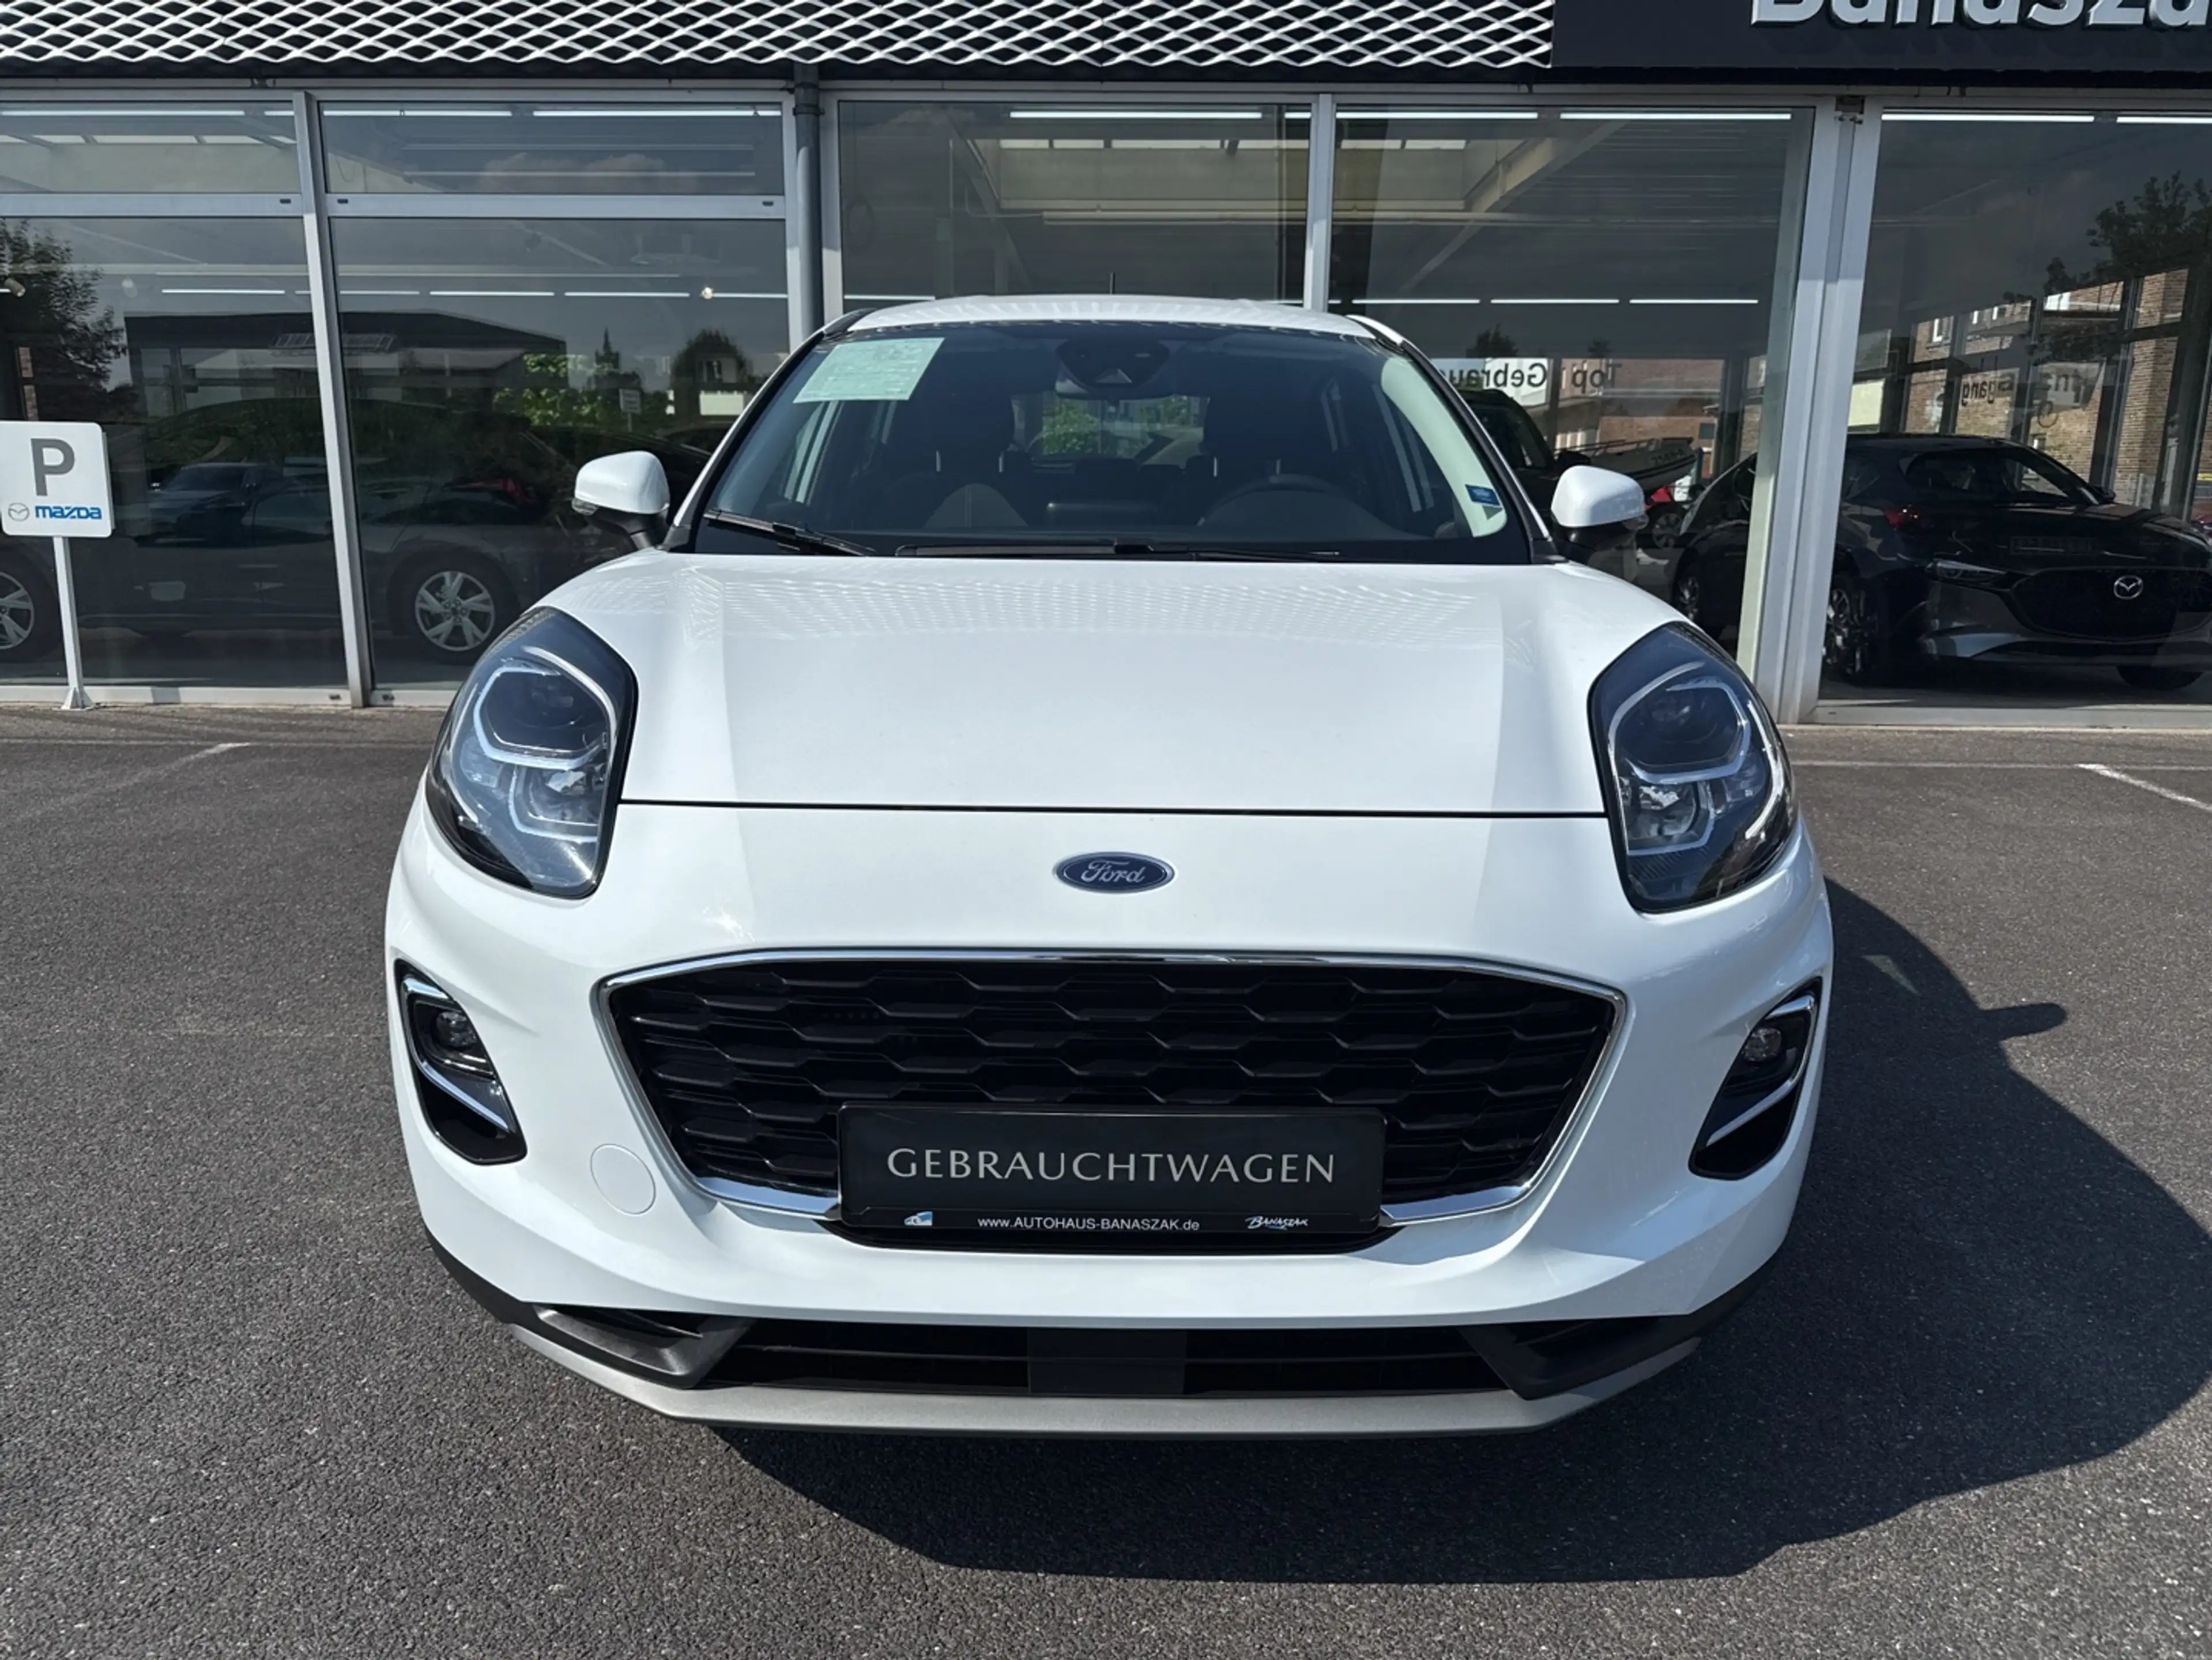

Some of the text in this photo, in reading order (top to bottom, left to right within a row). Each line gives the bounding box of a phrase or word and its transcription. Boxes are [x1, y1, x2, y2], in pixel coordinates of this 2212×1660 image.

[31, 438, 75, 496] P
[35, 505, 102, 520] mazda
[1081, 859, 1146, 882] Ford
[887, 1148, 1334, 1183] GEBRAUCHTWAGEN
[977, 1216, 1200, 1232] www.AUTOHAUS-BANASZAK.de
